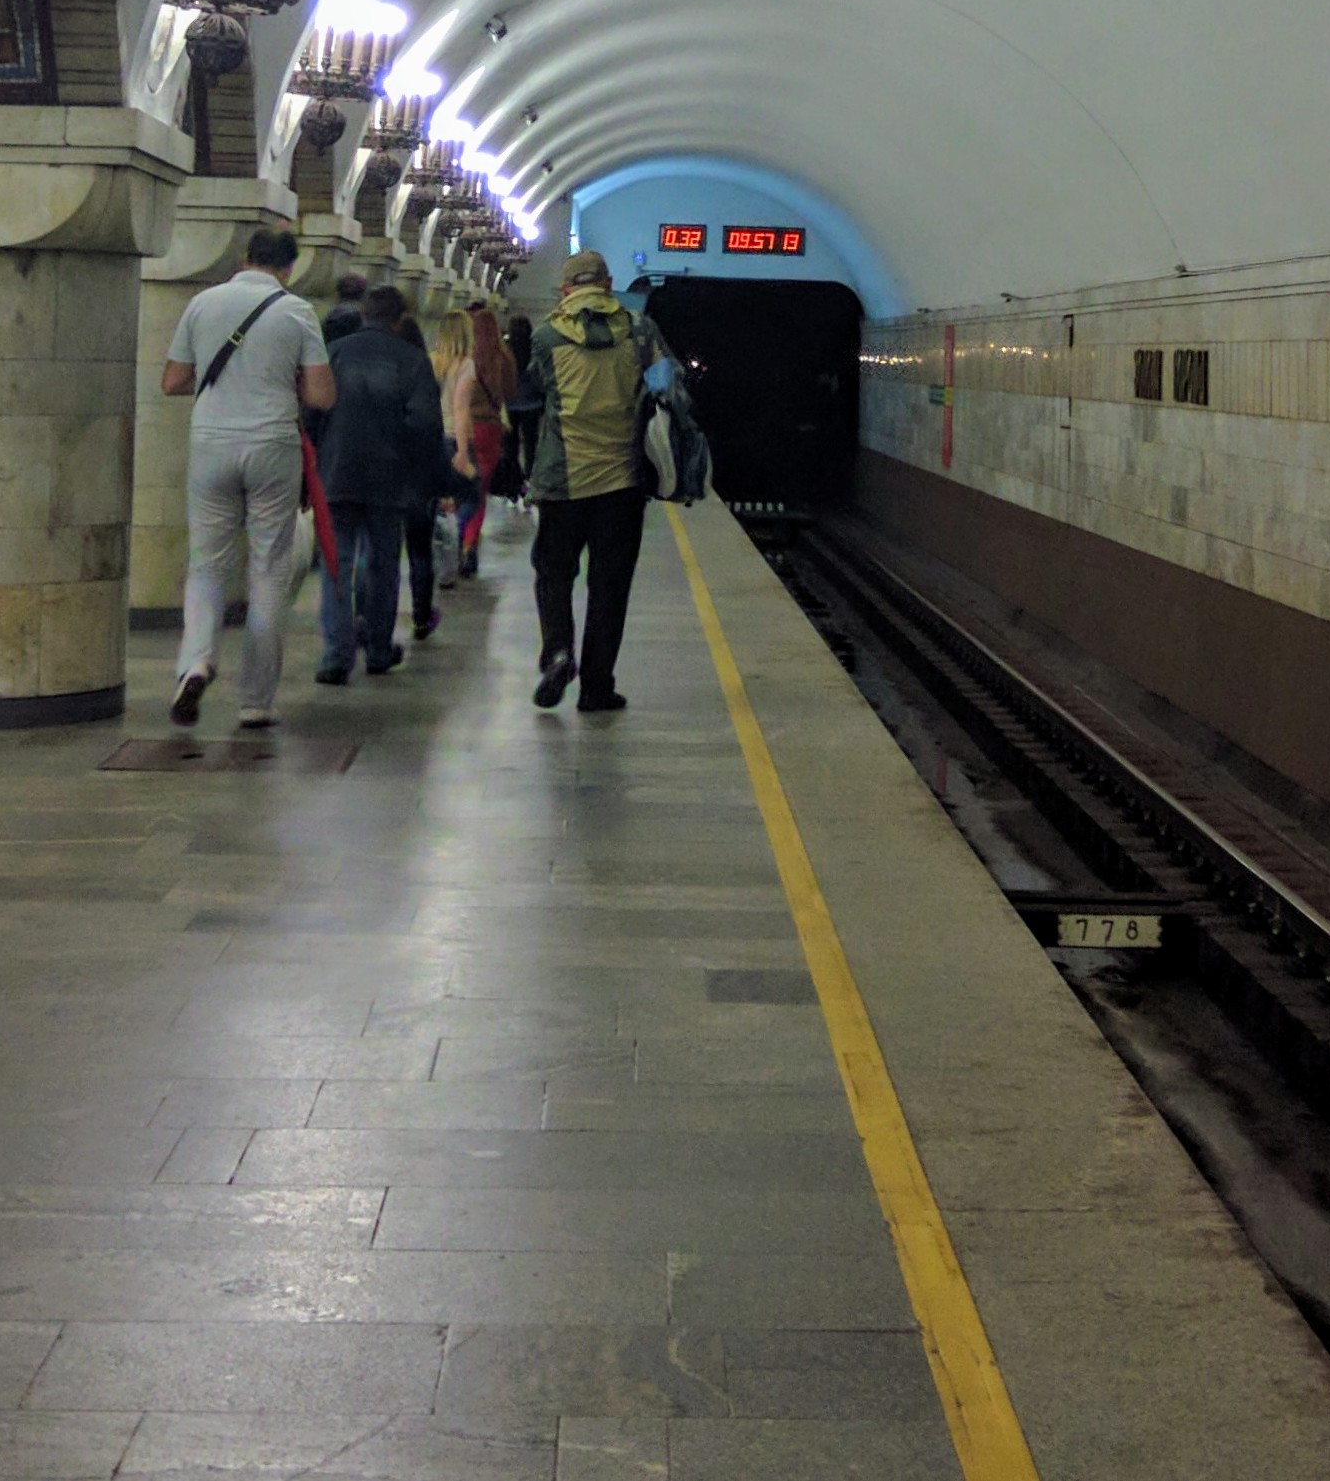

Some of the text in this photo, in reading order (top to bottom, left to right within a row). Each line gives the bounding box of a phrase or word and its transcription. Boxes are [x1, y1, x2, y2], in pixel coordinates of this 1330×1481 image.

[663, 229, 702, 248] 0.32
[782, 233, 800, 251] 13
[1075, 918, 1139, 942] 778
